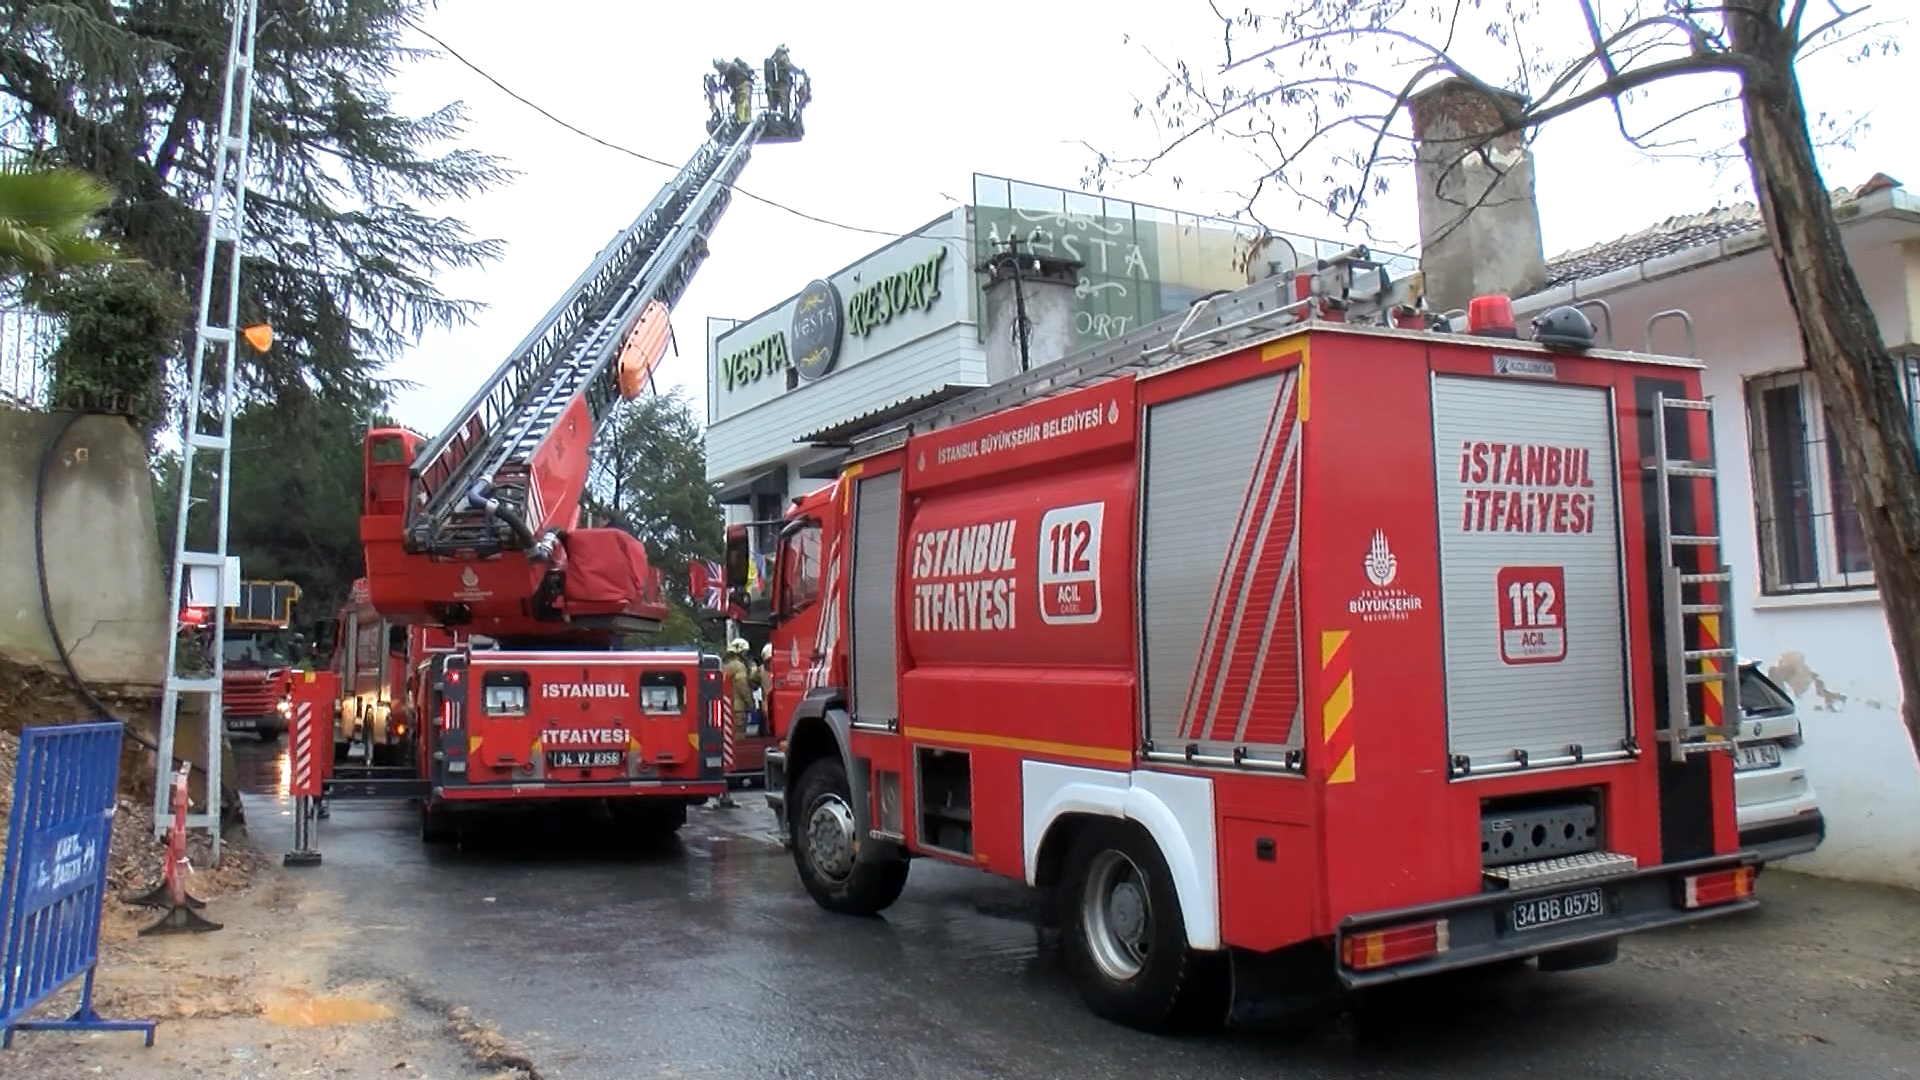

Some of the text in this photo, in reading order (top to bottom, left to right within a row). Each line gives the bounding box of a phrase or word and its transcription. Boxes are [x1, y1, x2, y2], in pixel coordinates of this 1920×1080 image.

[720, 246, 948, 392] VESTA RESORT
[1076, 311, 1133, 340] ORT
[937, 403, 1103, 465] İSTANBUL BÜYÜKŞEHİR BELEDİYESİ
[1459, 441, 1594, 488] İSTANBUL
[912, 519, 1017, 579] İSTANBUL
[1050, 520, 1091, 575] 112
[1349, 594, 1422, 613] BÜYÜKŞEHİR
[1508, 581, 1557, 626] 112
[542, 683, 630, 698] İSTANBUL
[1517, 891, 1599, 926] 34 BB 0579
